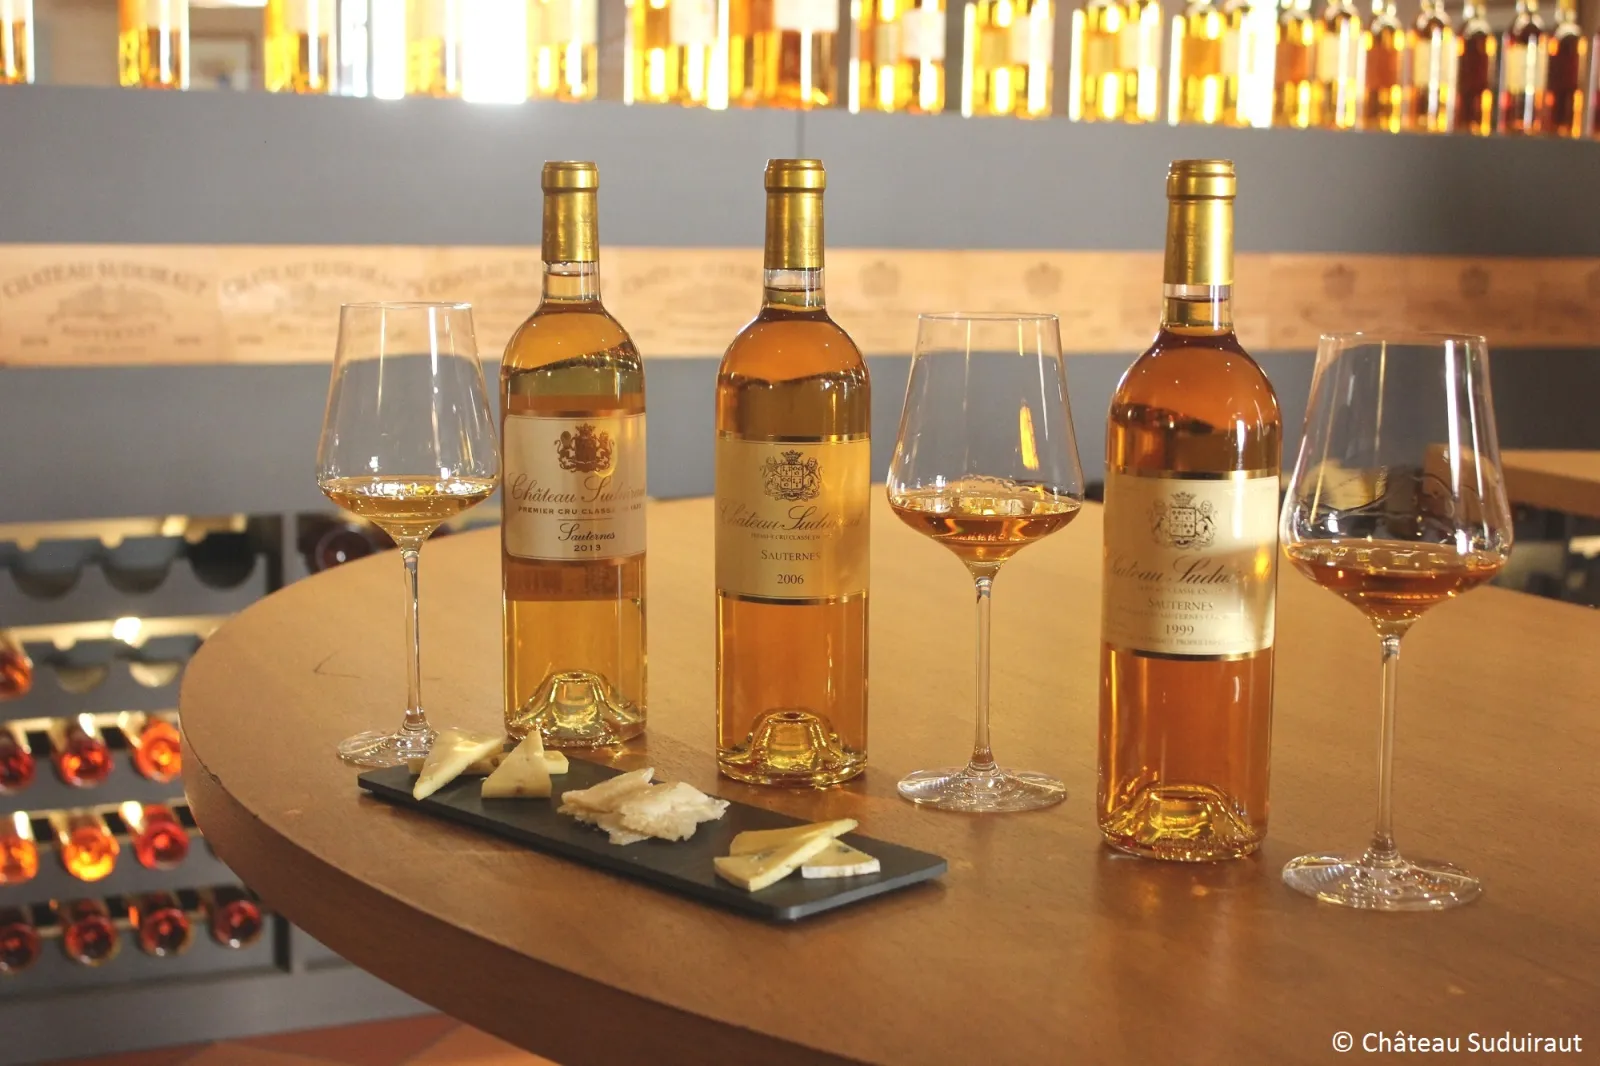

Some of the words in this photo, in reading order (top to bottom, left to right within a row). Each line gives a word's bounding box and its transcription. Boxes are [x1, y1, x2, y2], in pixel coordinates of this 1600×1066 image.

[509, 472, 577, 504] Château
[518, 506, 554, 515] PREMIER
[557, 507, 578, 516] CRU
[557, 522, 616, 542] Sauternes
[573, 544, 602, 553] 2013
[777, 573, 805, 585] 2006
[1165, 624, 1195, 637] 1999
